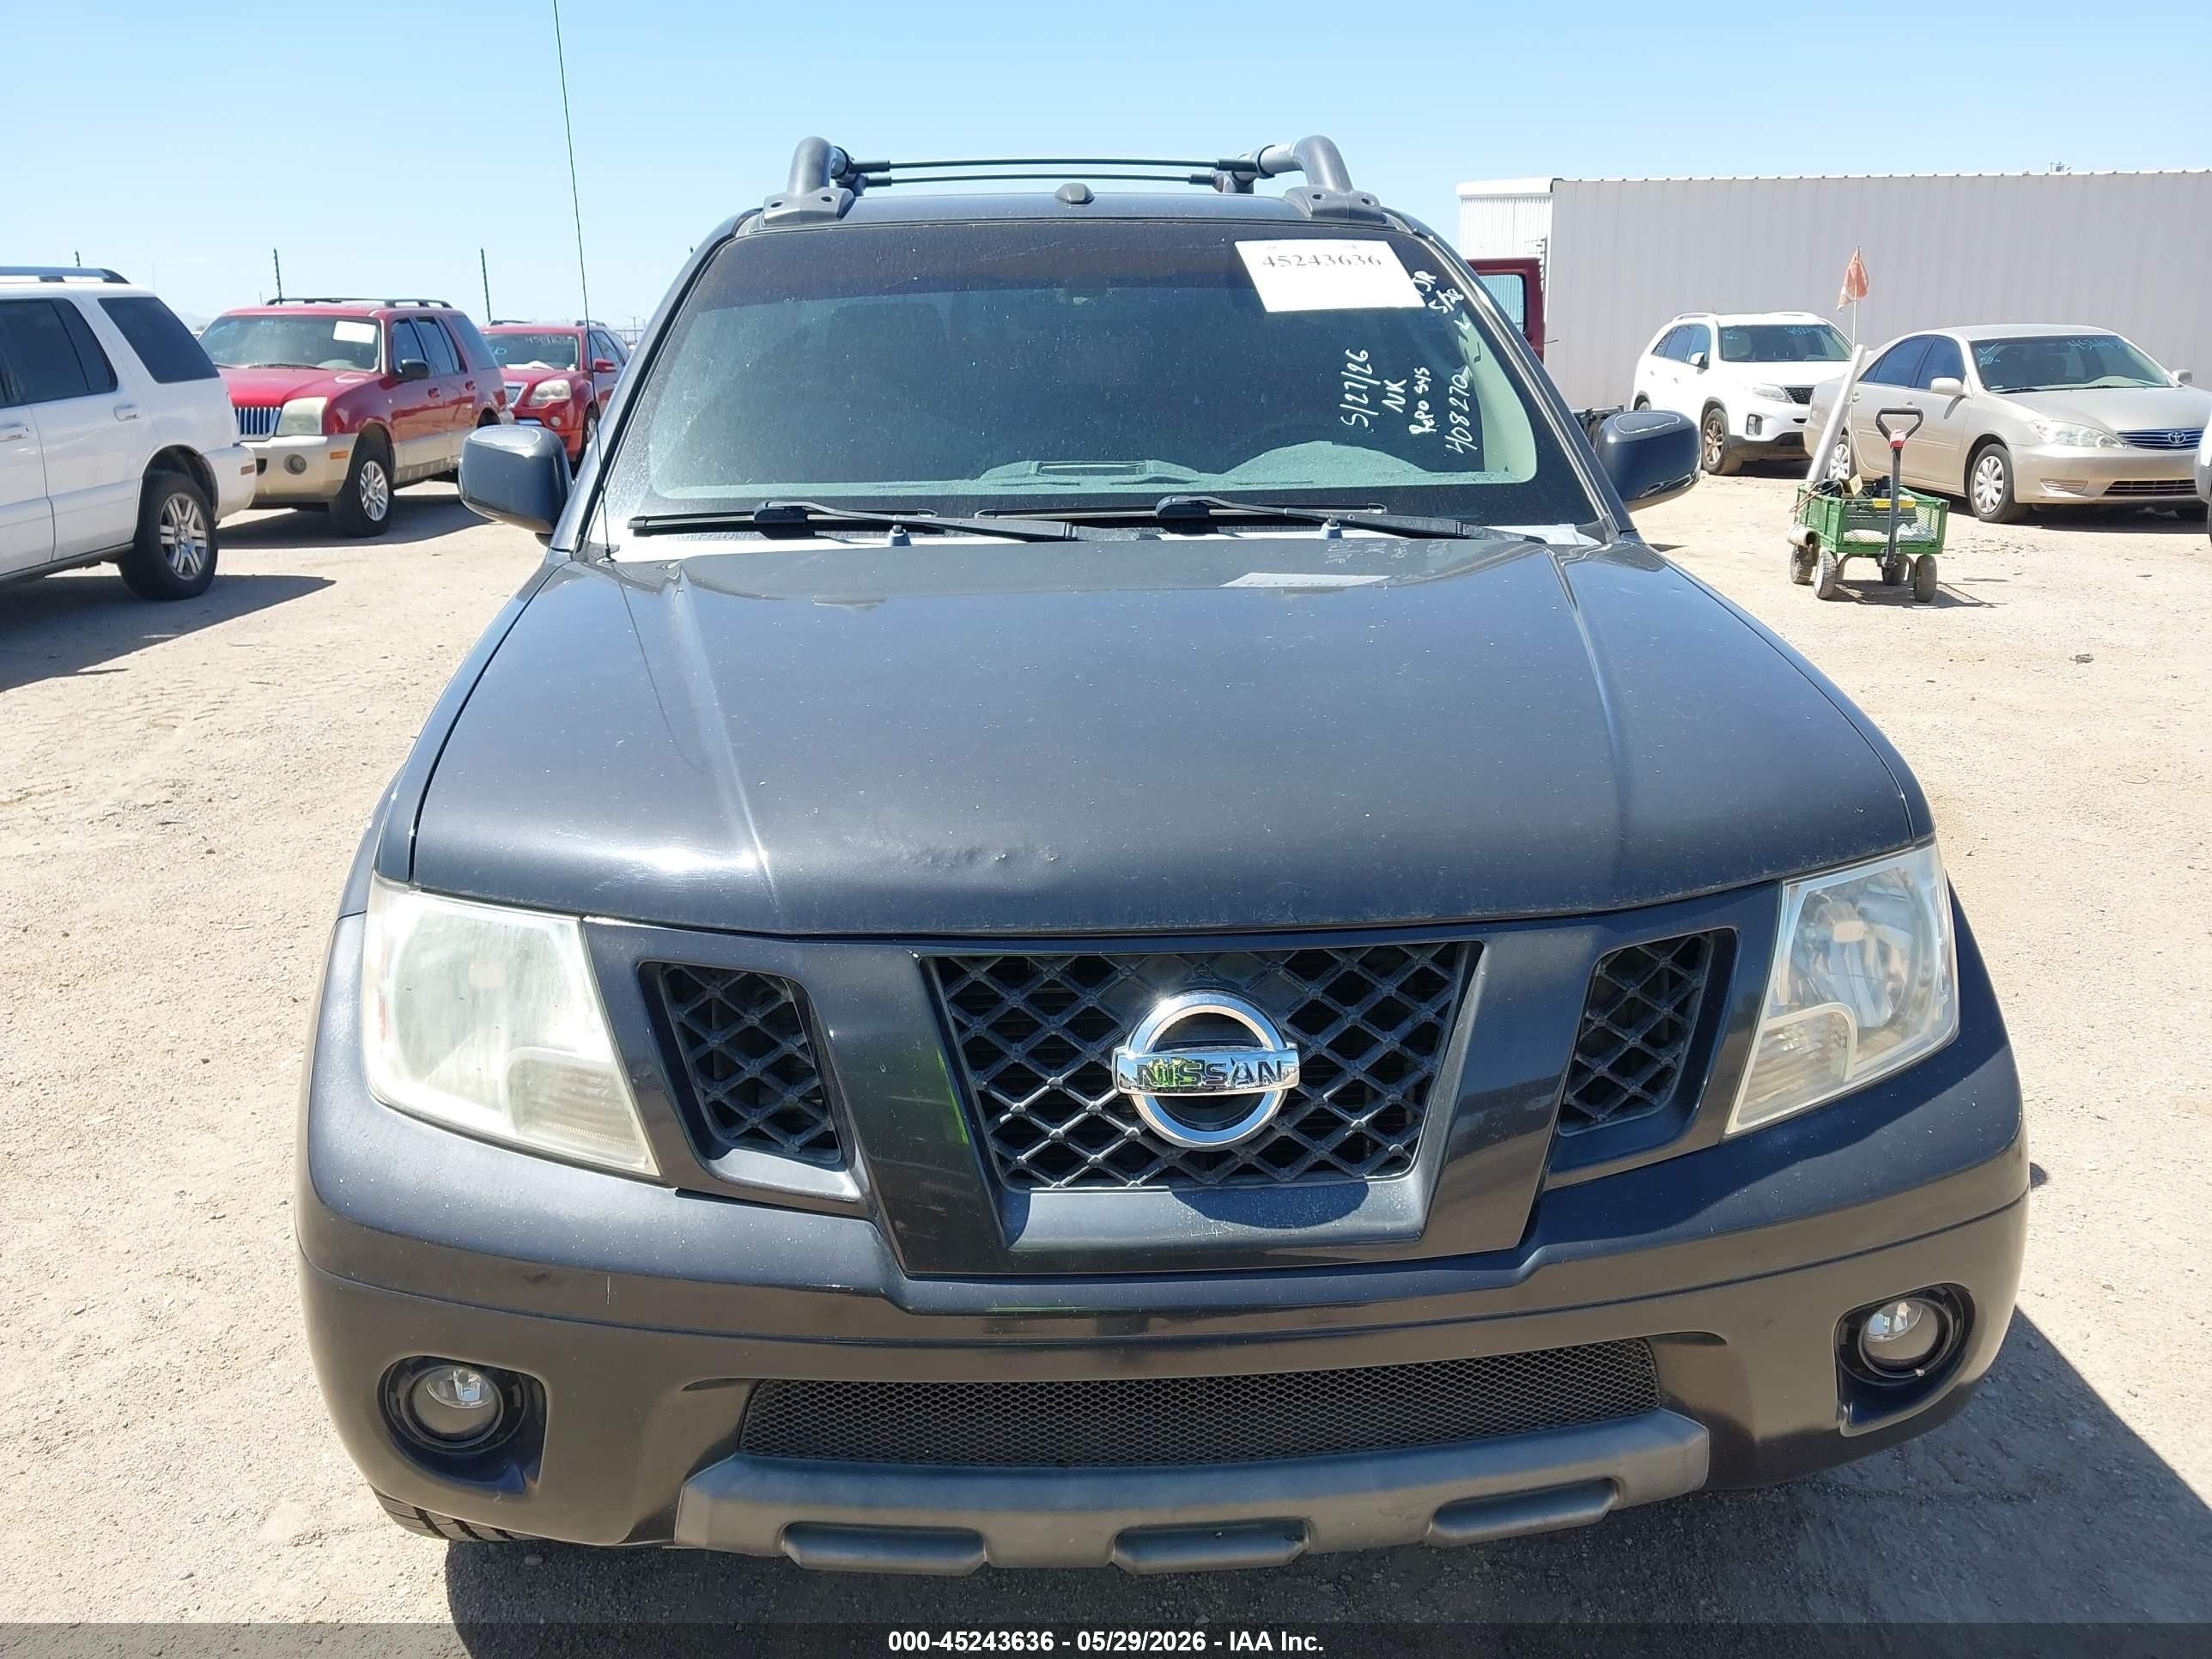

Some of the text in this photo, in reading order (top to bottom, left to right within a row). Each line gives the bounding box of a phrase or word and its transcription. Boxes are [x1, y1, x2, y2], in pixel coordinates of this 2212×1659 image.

[1262, 253, 1382, 268] 45243636
[1339, 349, 1382, 428] 5/27/26
[1382, 379, 1408, 414] NK
[1443, 374, 1479, 455] 408270
[1136, 1057, 1284, 1089] NISSAN
